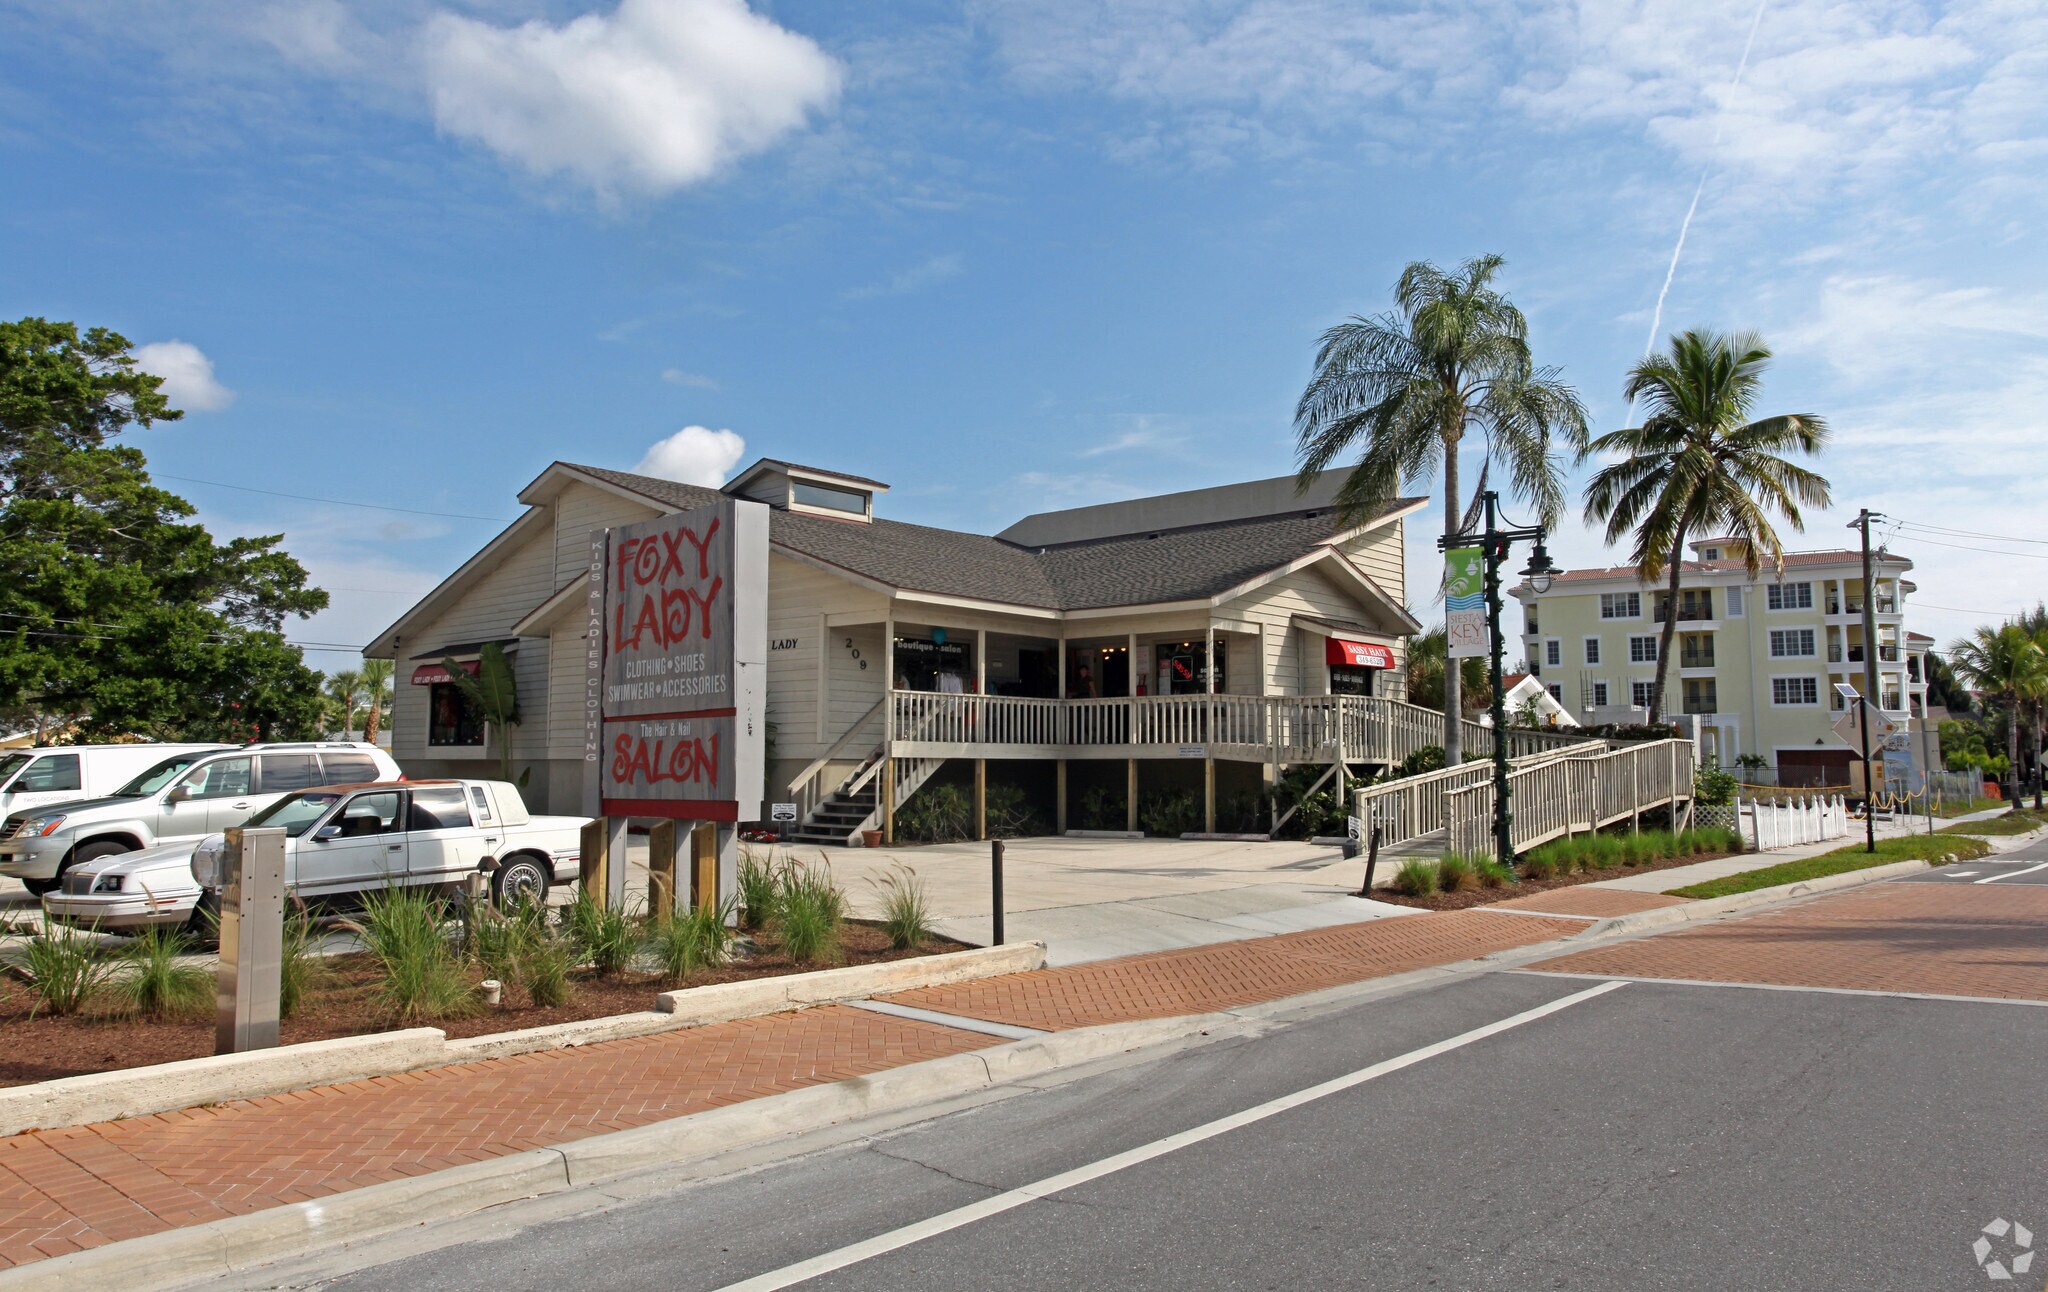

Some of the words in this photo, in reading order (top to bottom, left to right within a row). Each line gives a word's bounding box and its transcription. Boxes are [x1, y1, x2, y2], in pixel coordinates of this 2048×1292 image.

[591, 541, 602, 581] KIDS
[617, 516, 720, 592] FOXY
[590, 590, 600, 598] &
[615, 575, 722, 654] LADY
[1450, 613, 1482, 624] SIESTA
[588, 608, 600, 669] LADIES
[1451, 623, 1482, 638] KEY
[771, 638, 798, 650] LADY
[897, 641, 934, 652] boutique
[940, 644, 962, 653] salon
[1347, 644, 1368, 655] SASSY
[1368, 647, 1388, 657] HAIR
[1452, 637, 1484, 647] VILLAGE
[626, 657, 666, 679] CLOTHING
[674, 653, 705, 673] SHOES
[608, 681, 655, 703] SWIMWEAR
[662, 674, 727, 698] ACCESSORIES
[585, 678, 598, 761] CLOTHING
[641, 723, 652, 737] The
[654, 722, 668, 736] Hair
[670, 722, 675, 736] &
[678, 721, 691, 736] Nail
[611, 732, 718, 790] SALON
